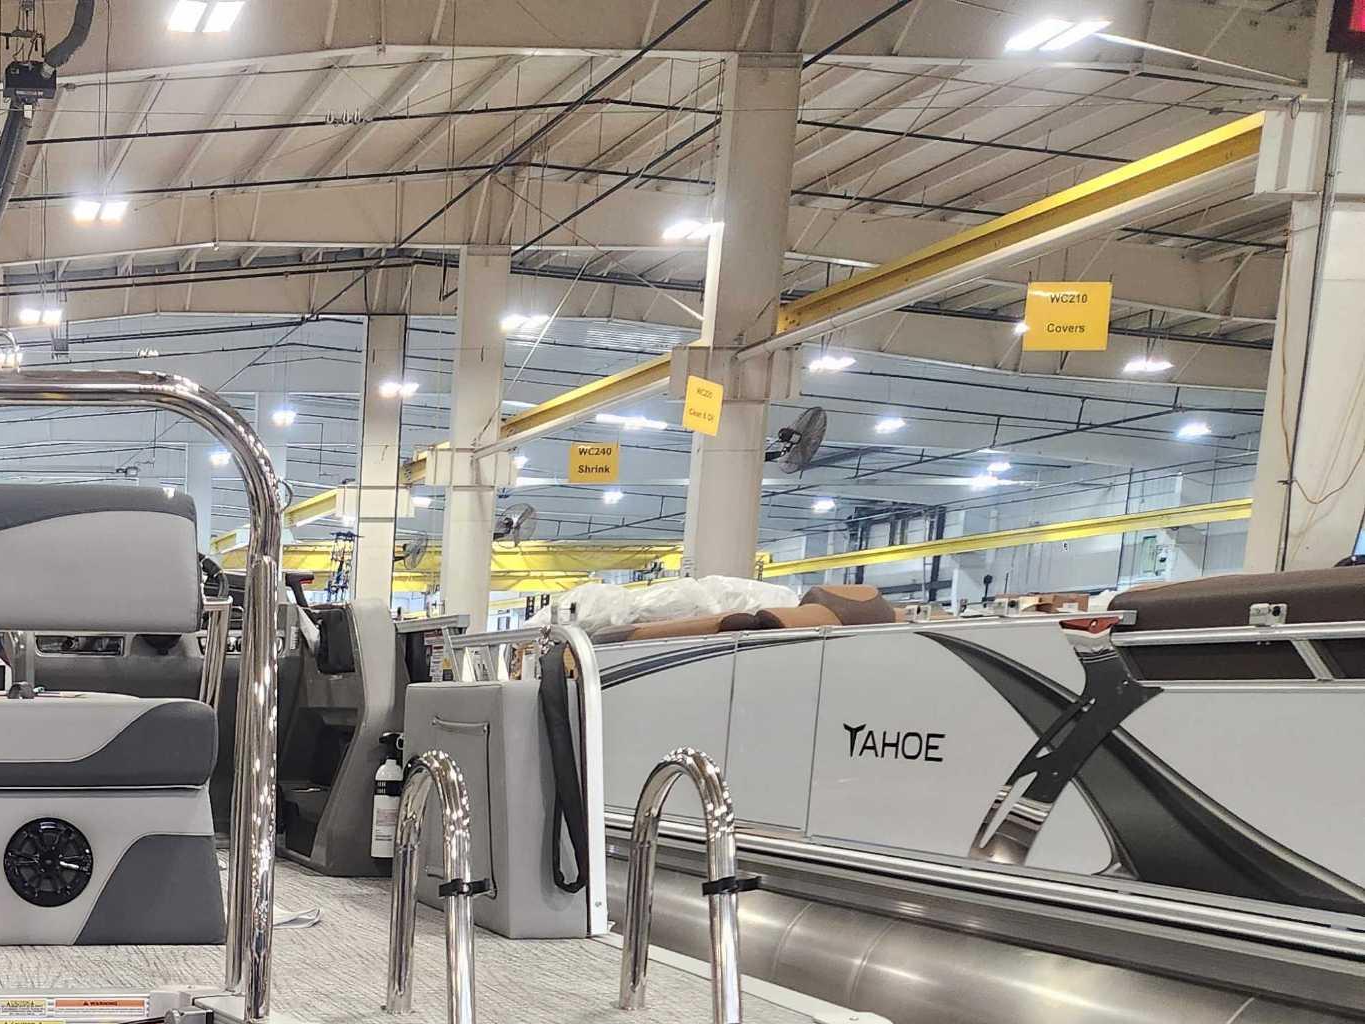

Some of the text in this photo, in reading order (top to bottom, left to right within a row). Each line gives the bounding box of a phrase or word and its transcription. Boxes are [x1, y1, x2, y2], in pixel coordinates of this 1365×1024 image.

[1050, 293, 1088, 304] WC210
[1046, 323, 1085, 333] Covers
[578, 447, 612, 456] WC240
[578, 464, 611, 473] Shrink
[843, 723, 947, 762] TAHOE
